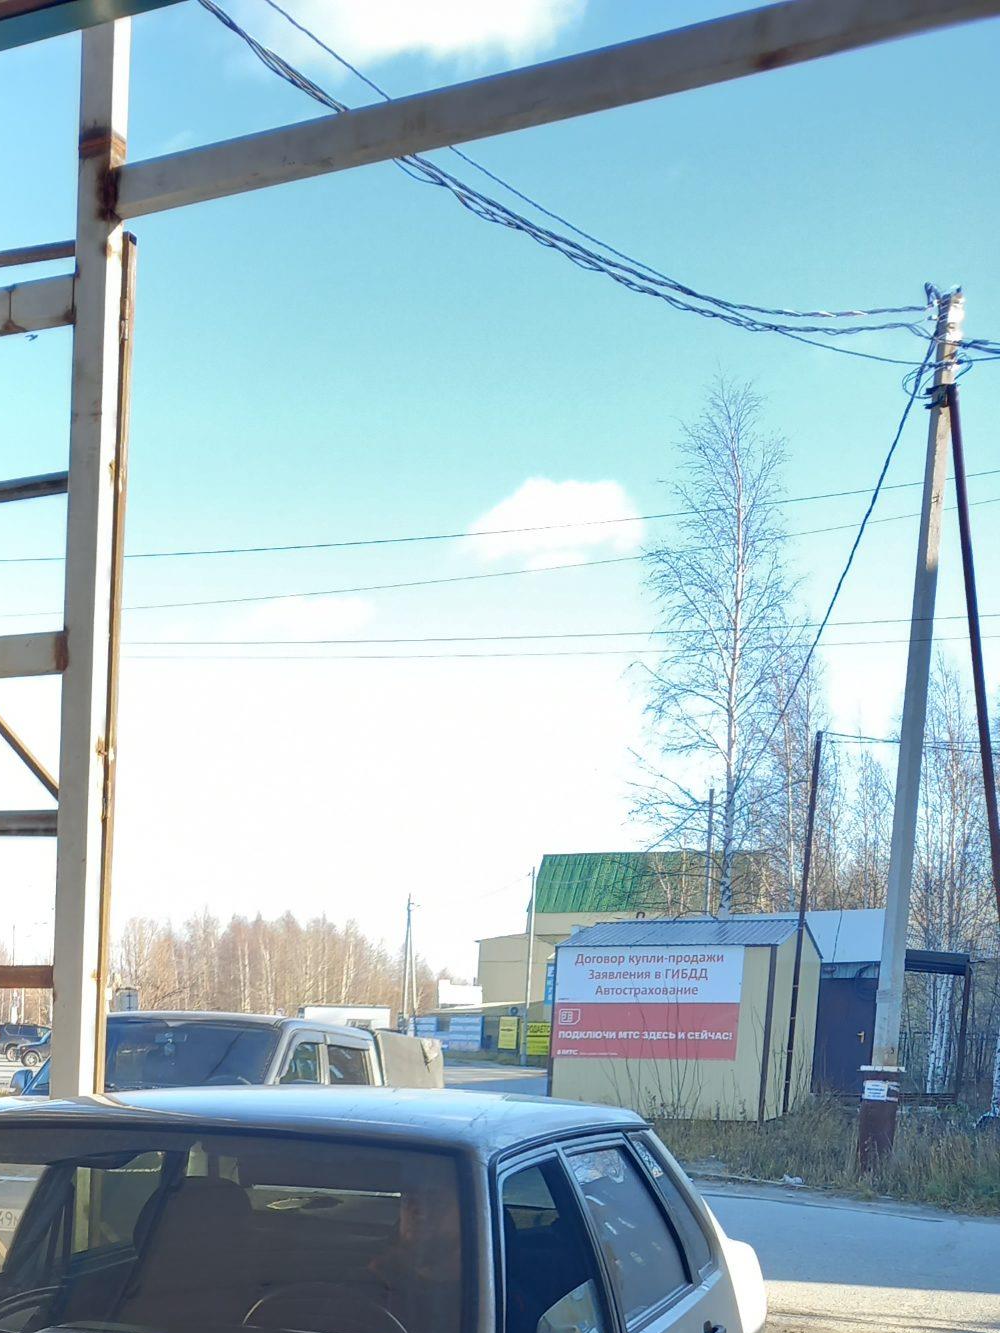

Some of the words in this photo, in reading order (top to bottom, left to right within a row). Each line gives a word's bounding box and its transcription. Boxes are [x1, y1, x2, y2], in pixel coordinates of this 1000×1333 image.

[575, 953, 625, 966] Договор
[628, 952, 724, 965] купли-продажи
[588, 969, 650, 980] Заявления
[654, 970, 661, 979] в
[665, 968, 708, 981] ГИБДД
[595, 985, 699, 996] Автострахование
[558, 1031, 616, 1040] ПОДКЛЮЧИ
[618, 1031, 640, 1039] МТС
[642, 1031, 676, 1040] ЗДЕСЬ
[678, 1031, 685, 1040] И
[687, 1030, 733, 1040] СЕЙЧАС!
